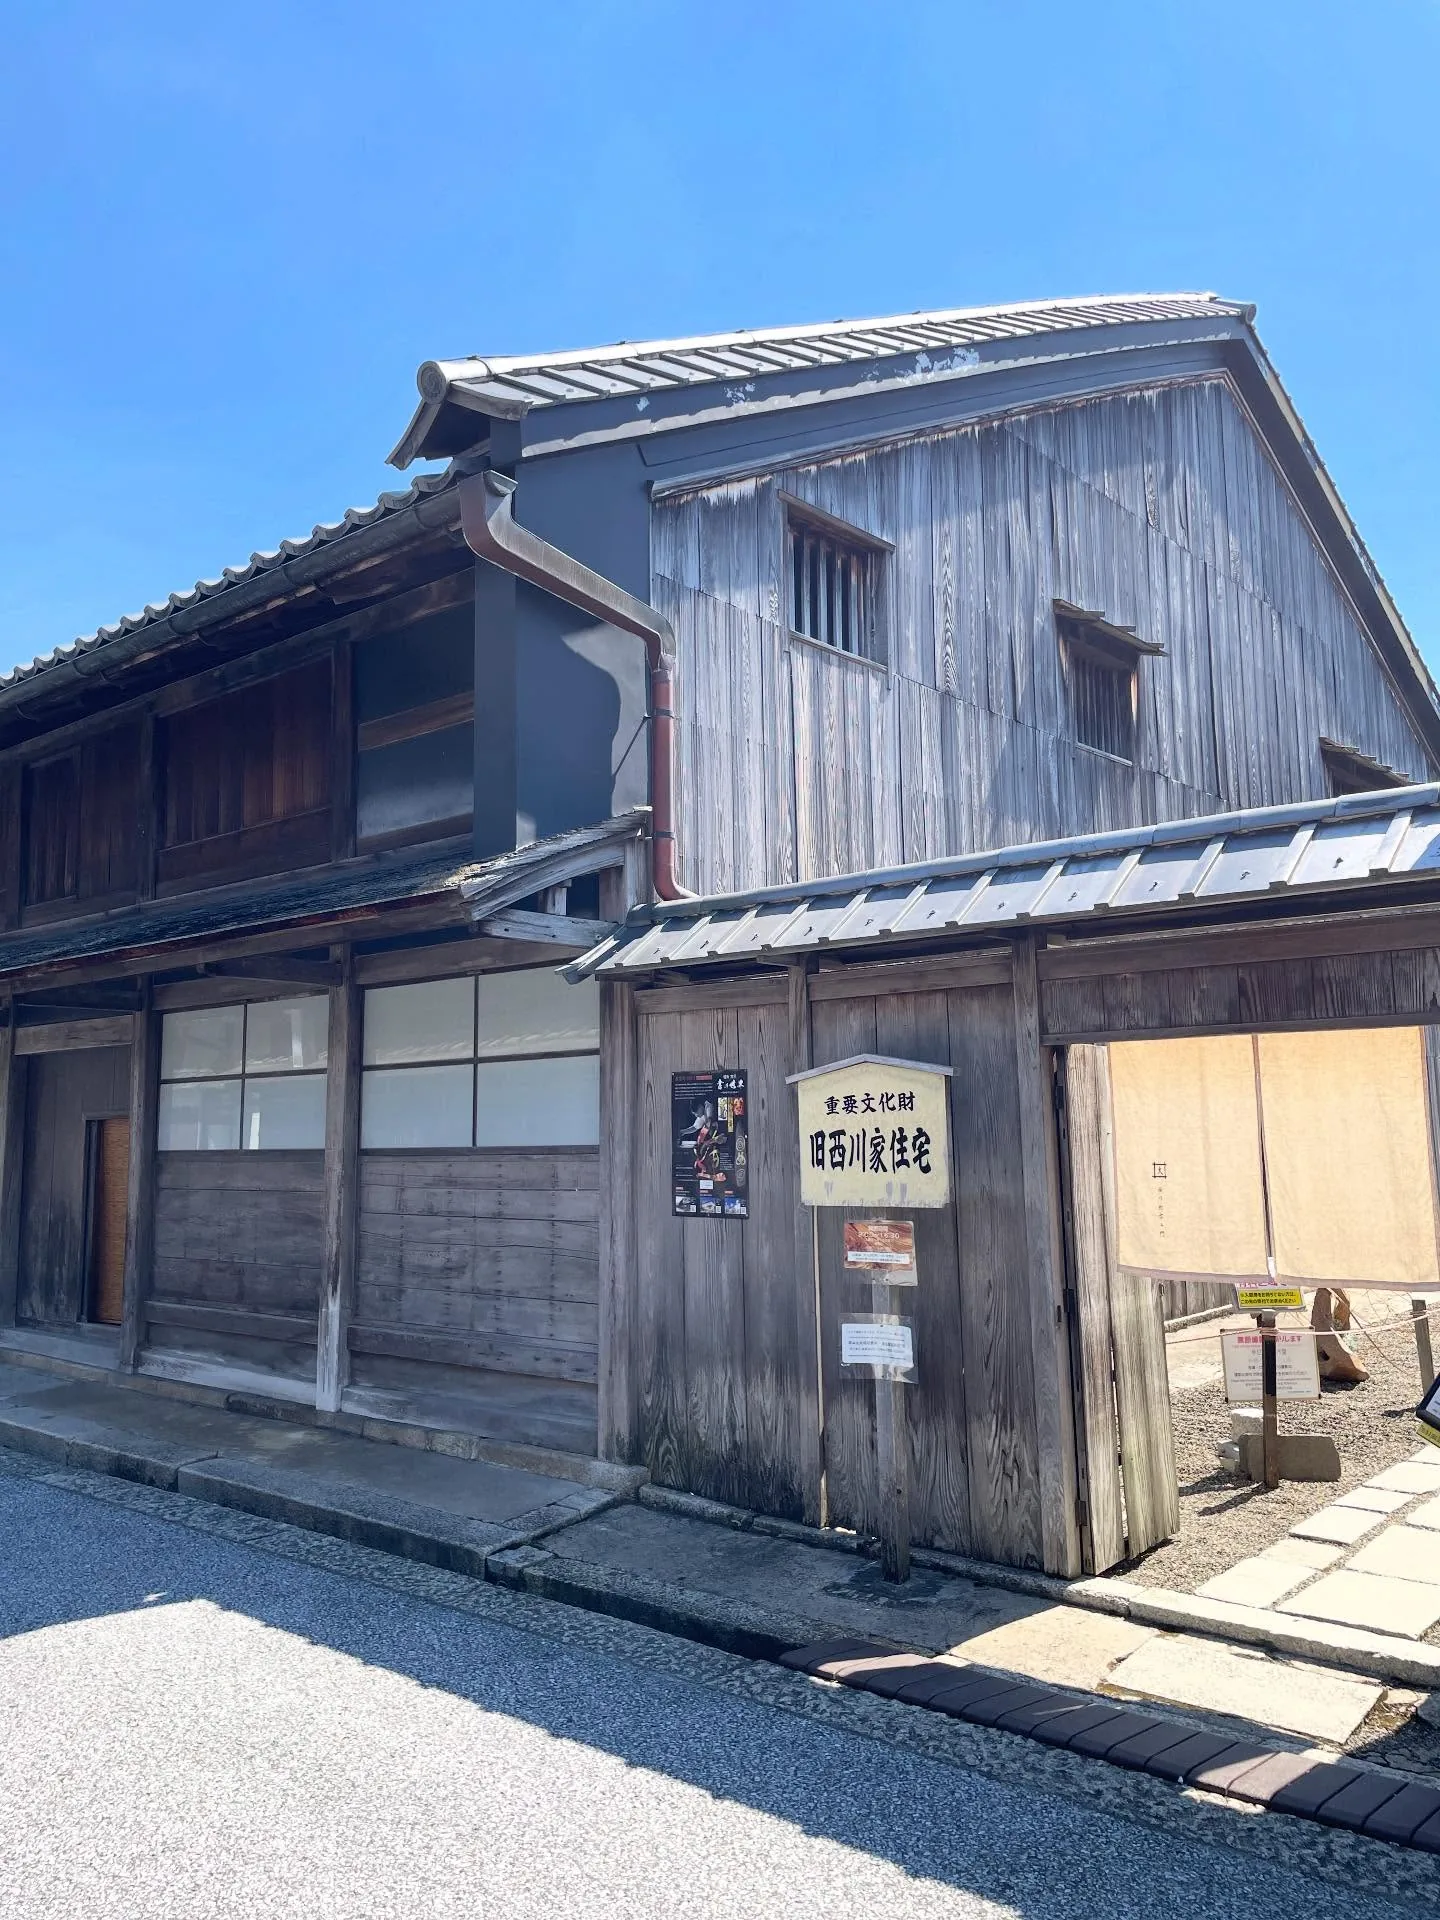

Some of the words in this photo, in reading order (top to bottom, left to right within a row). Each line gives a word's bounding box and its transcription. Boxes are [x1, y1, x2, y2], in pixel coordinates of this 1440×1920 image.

[824, 1091, 916, 1115] 重要文化財
[810, 1127, 932, 1174] 旧西川家住宅
